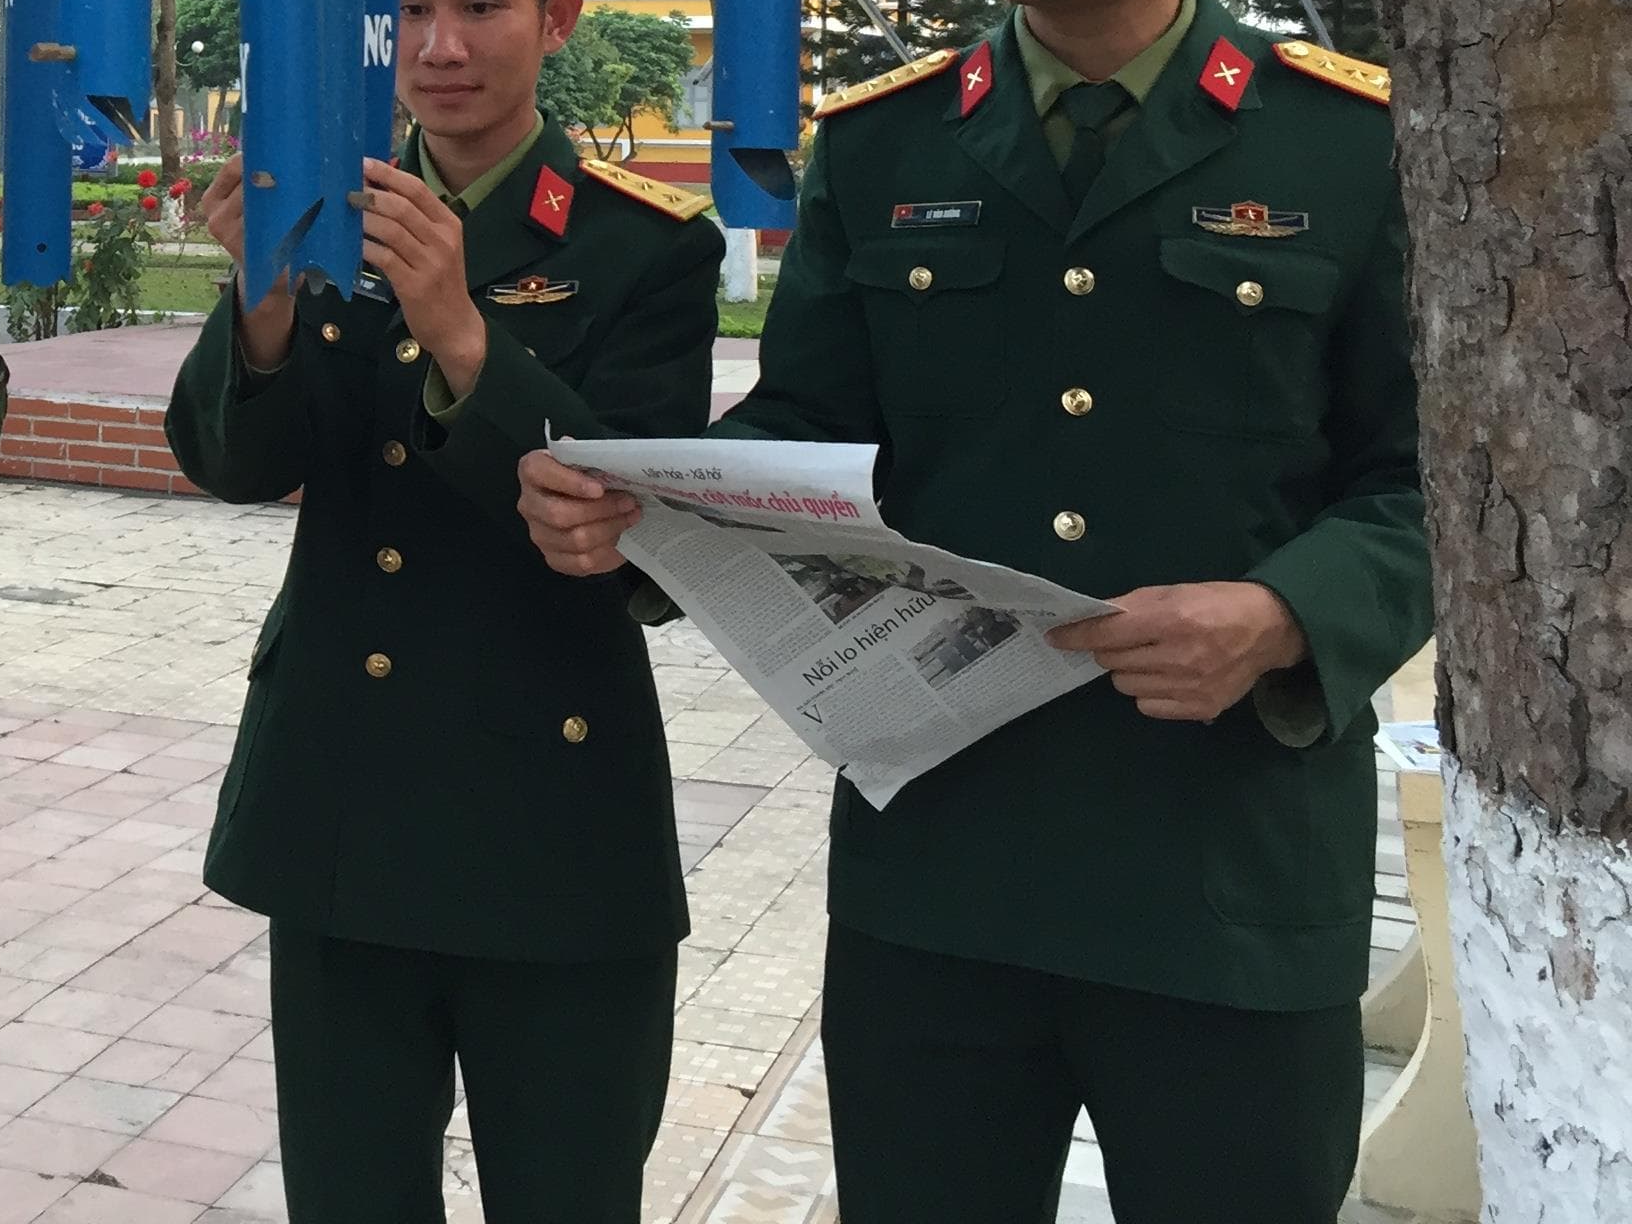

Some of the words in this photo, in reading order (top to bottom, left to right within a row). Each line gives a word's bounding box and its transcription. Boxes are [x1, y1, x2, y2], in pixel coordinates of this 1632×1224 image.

[767, 491, 803, 513] chủ
[803, 490, 860, 521] quyền
[834, 647, 857, 665] lo
[853, 618, 900, 652] hiện
[894, 594, 937, 623] hữu
